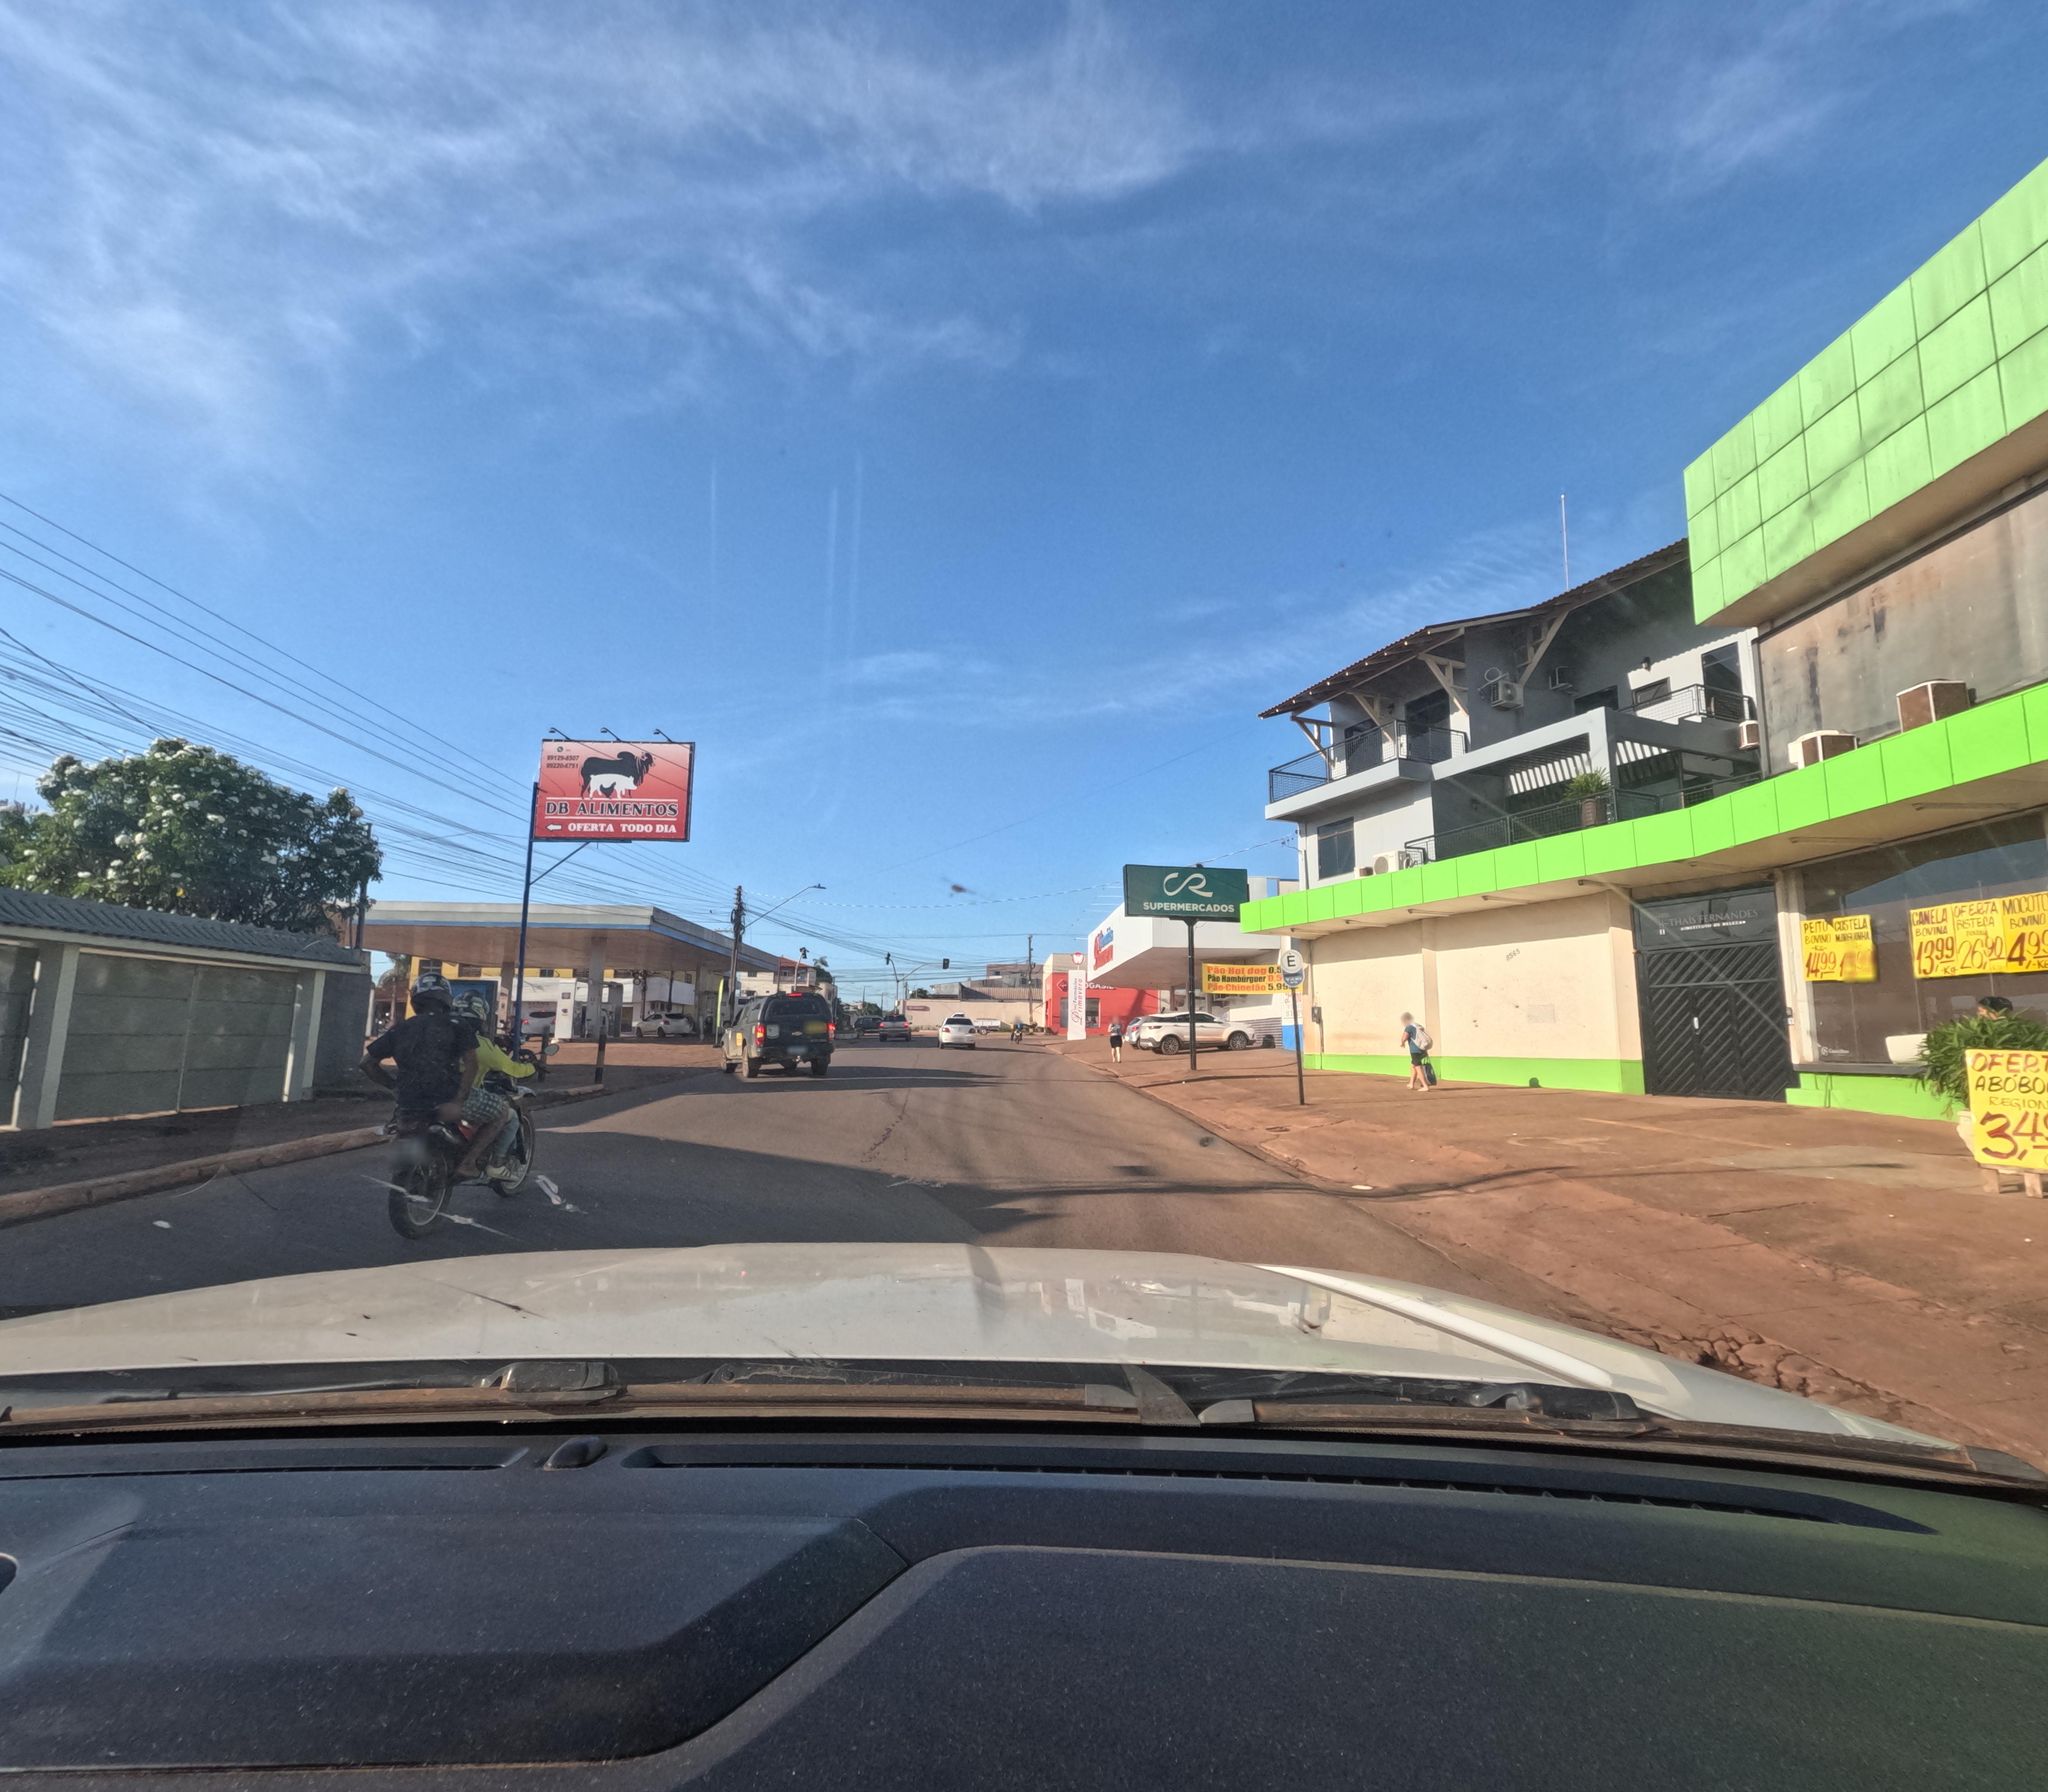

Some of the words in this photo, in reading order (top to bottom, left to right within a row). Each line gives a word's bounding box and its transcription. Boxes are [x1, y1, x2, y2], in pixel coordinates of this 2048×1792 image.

[545, 801, 569, 815] DB
[576, 802, 679, 817] ALIMENTOS
[567, 823, 614, 833] OFERTA
[620, 823, 653, 833] TODO
[655, 824, 677, 833] DIA
[1143, 902, 1235, 913] SUPERMERCADOS
[1699, 909, 1758, 923] FERNANDES
[2010, 913, 2046, 929] BOVINO
[1834, 918, 1868, 931] COSTELA
[1915, 926, 1948, 937] BOVINA
[1286, 955, 1296, 967] E
[1207, 974, 1220, 982] Pão
[1975, 1073, 2048, 1094] ABÓBO
